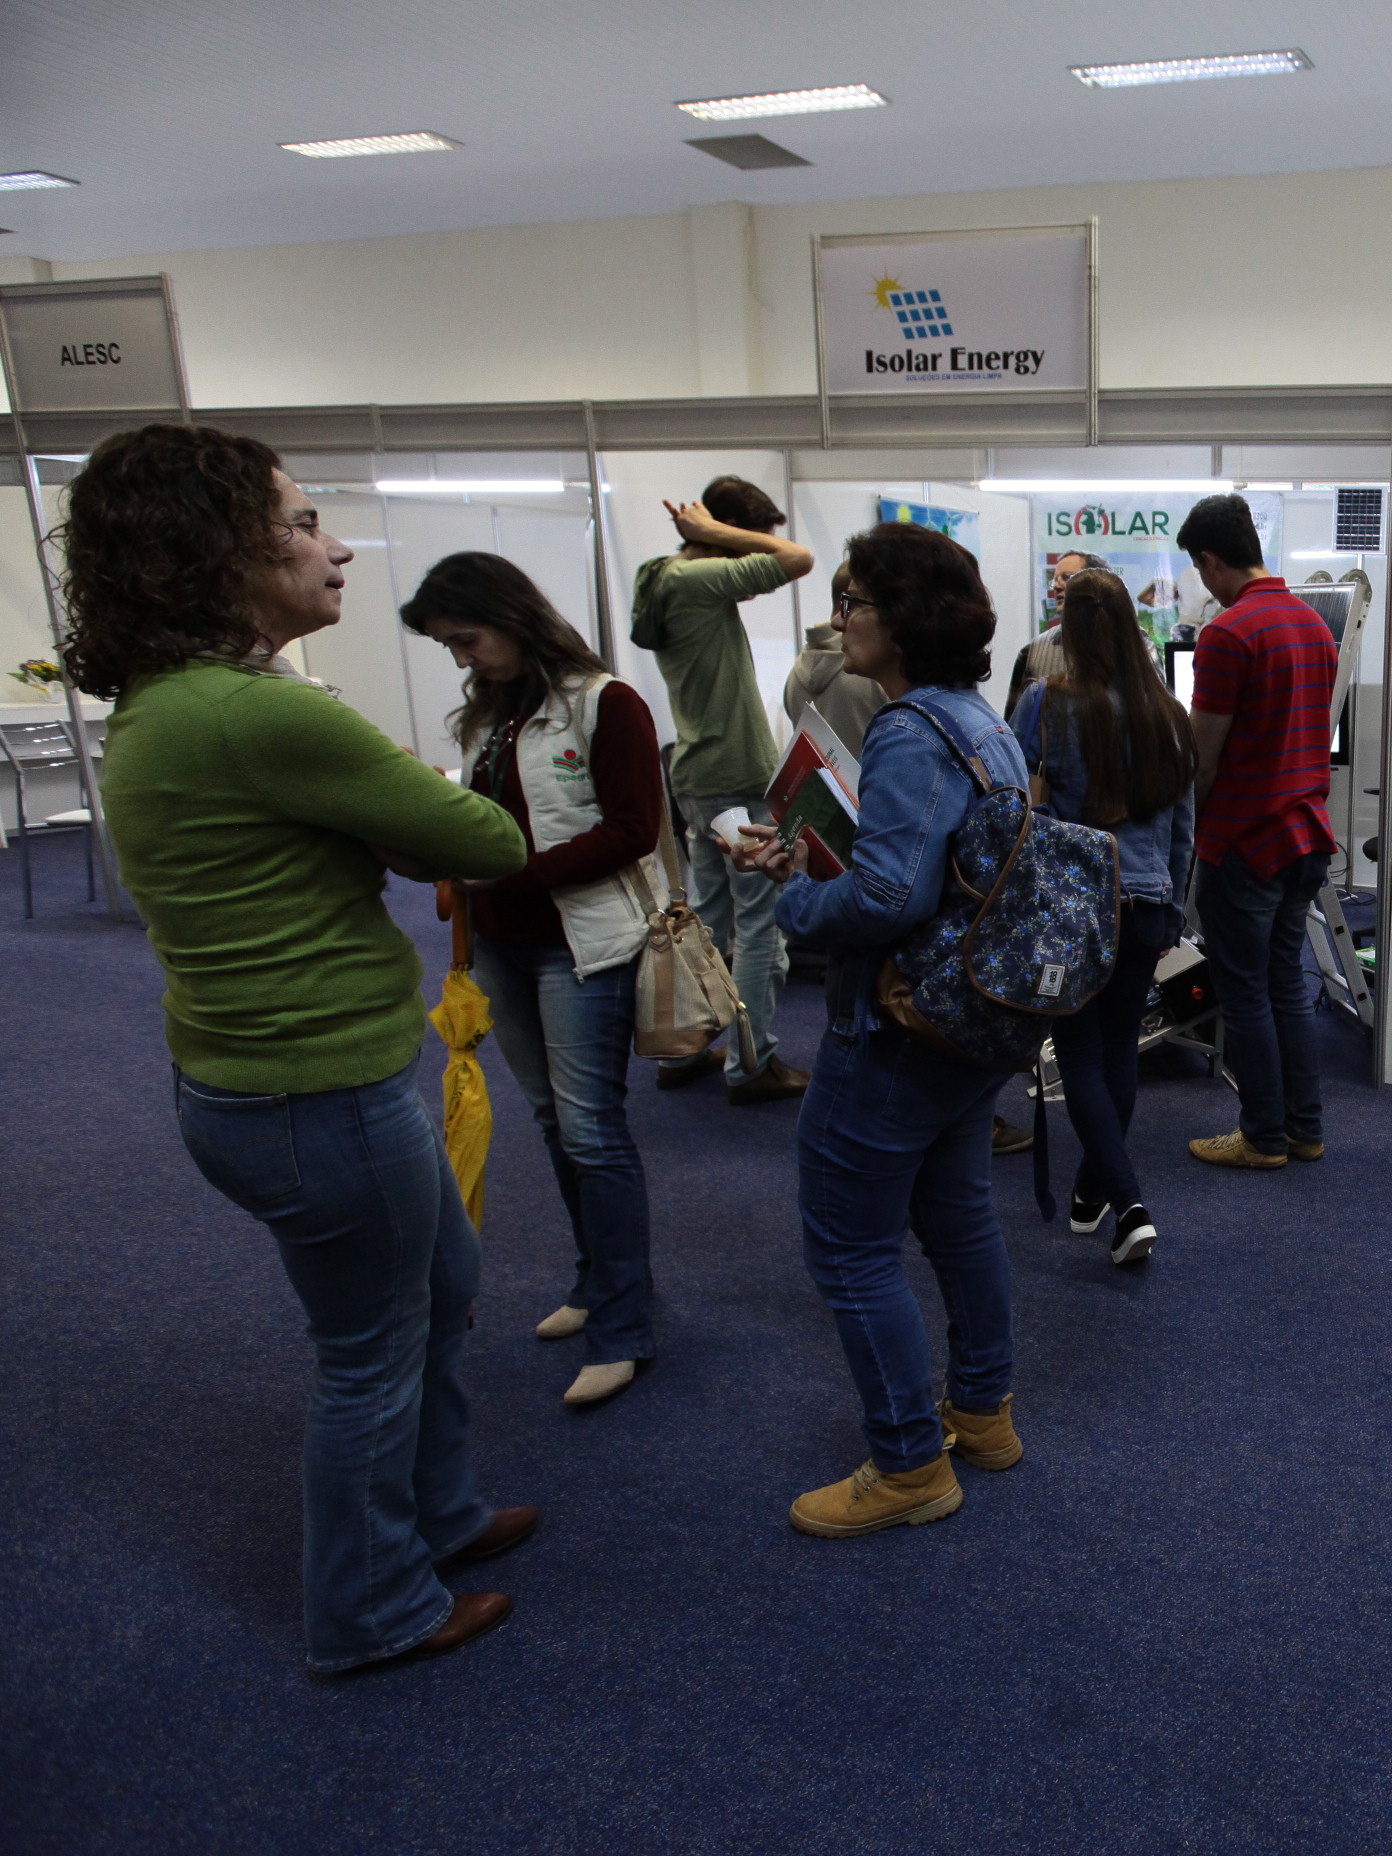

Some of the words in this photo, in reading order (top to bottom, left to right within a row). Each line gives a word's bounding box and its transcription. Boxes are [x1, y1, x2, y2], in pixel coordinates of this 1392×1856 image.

[60, 342, 121, 366] ALESC
[865, 349, 942, 374] Isolar
[950, 346, 1045, 375] Energy
